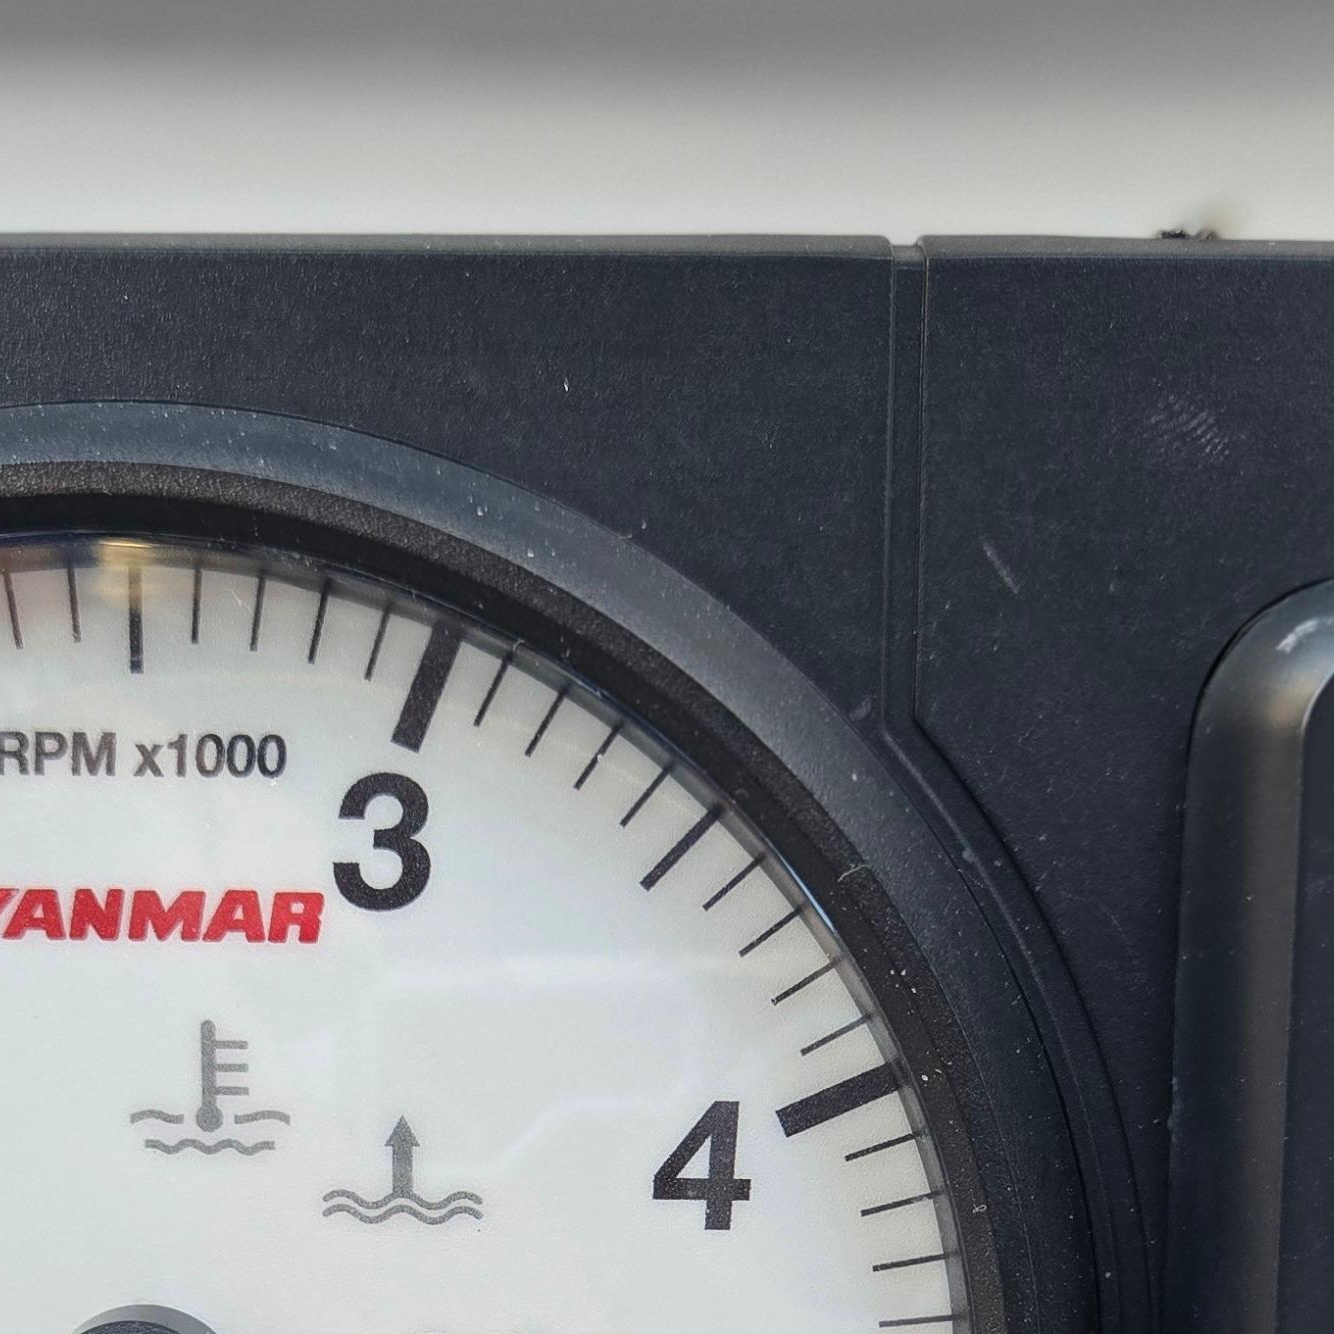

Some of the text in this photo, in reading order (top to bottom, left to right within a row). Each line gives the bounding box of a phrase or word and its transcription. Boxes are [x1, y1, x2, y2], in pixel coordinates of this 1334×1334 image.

[134, 734, 286, 778] x1000
[333, 772, 431, 911] 3
[653, 1101, 751, 1230] 4
